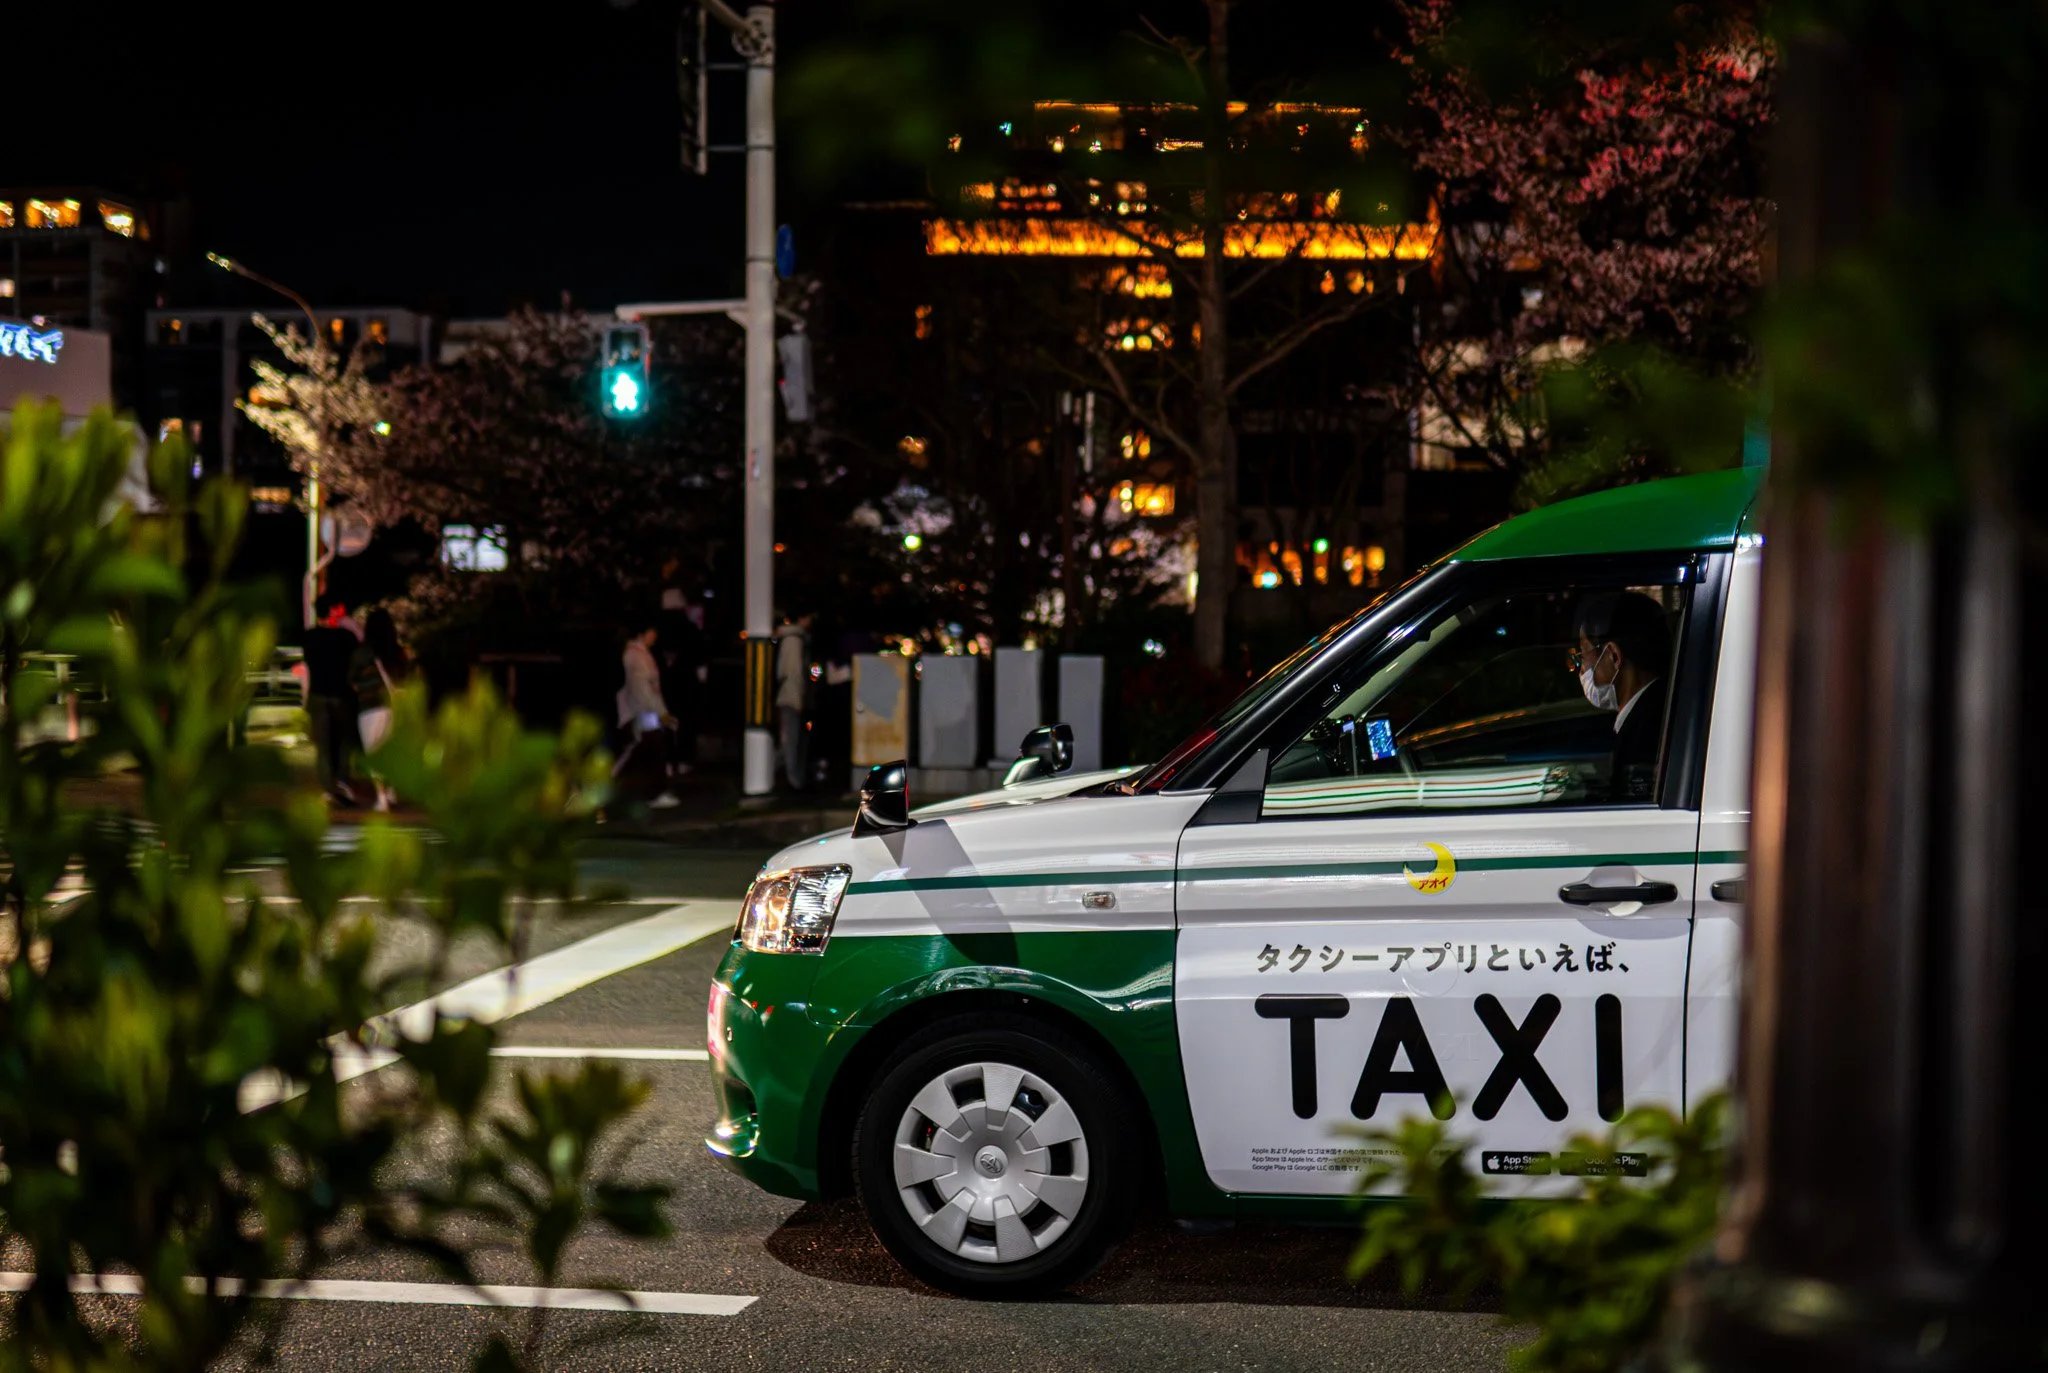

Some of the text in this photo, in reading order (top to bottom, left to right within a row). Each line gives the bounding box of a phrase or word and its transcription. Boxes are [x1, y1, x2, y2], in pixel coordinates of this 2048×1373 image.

[1418, 876, 1449, 891] アオイ
[1256, 941, 1629, 974] タクシーアプリといえば、
[1254, 992, 1625, 1124] TAXI
[1503, 1154, 1522, 1166] App
[1621, 1155, 1641, 1168] Play
[1252, 1164, 1273, 1172] Google
[1274, 1164, 1287, 1172] Play
[1294, 1164, 1316, 1172] Google
